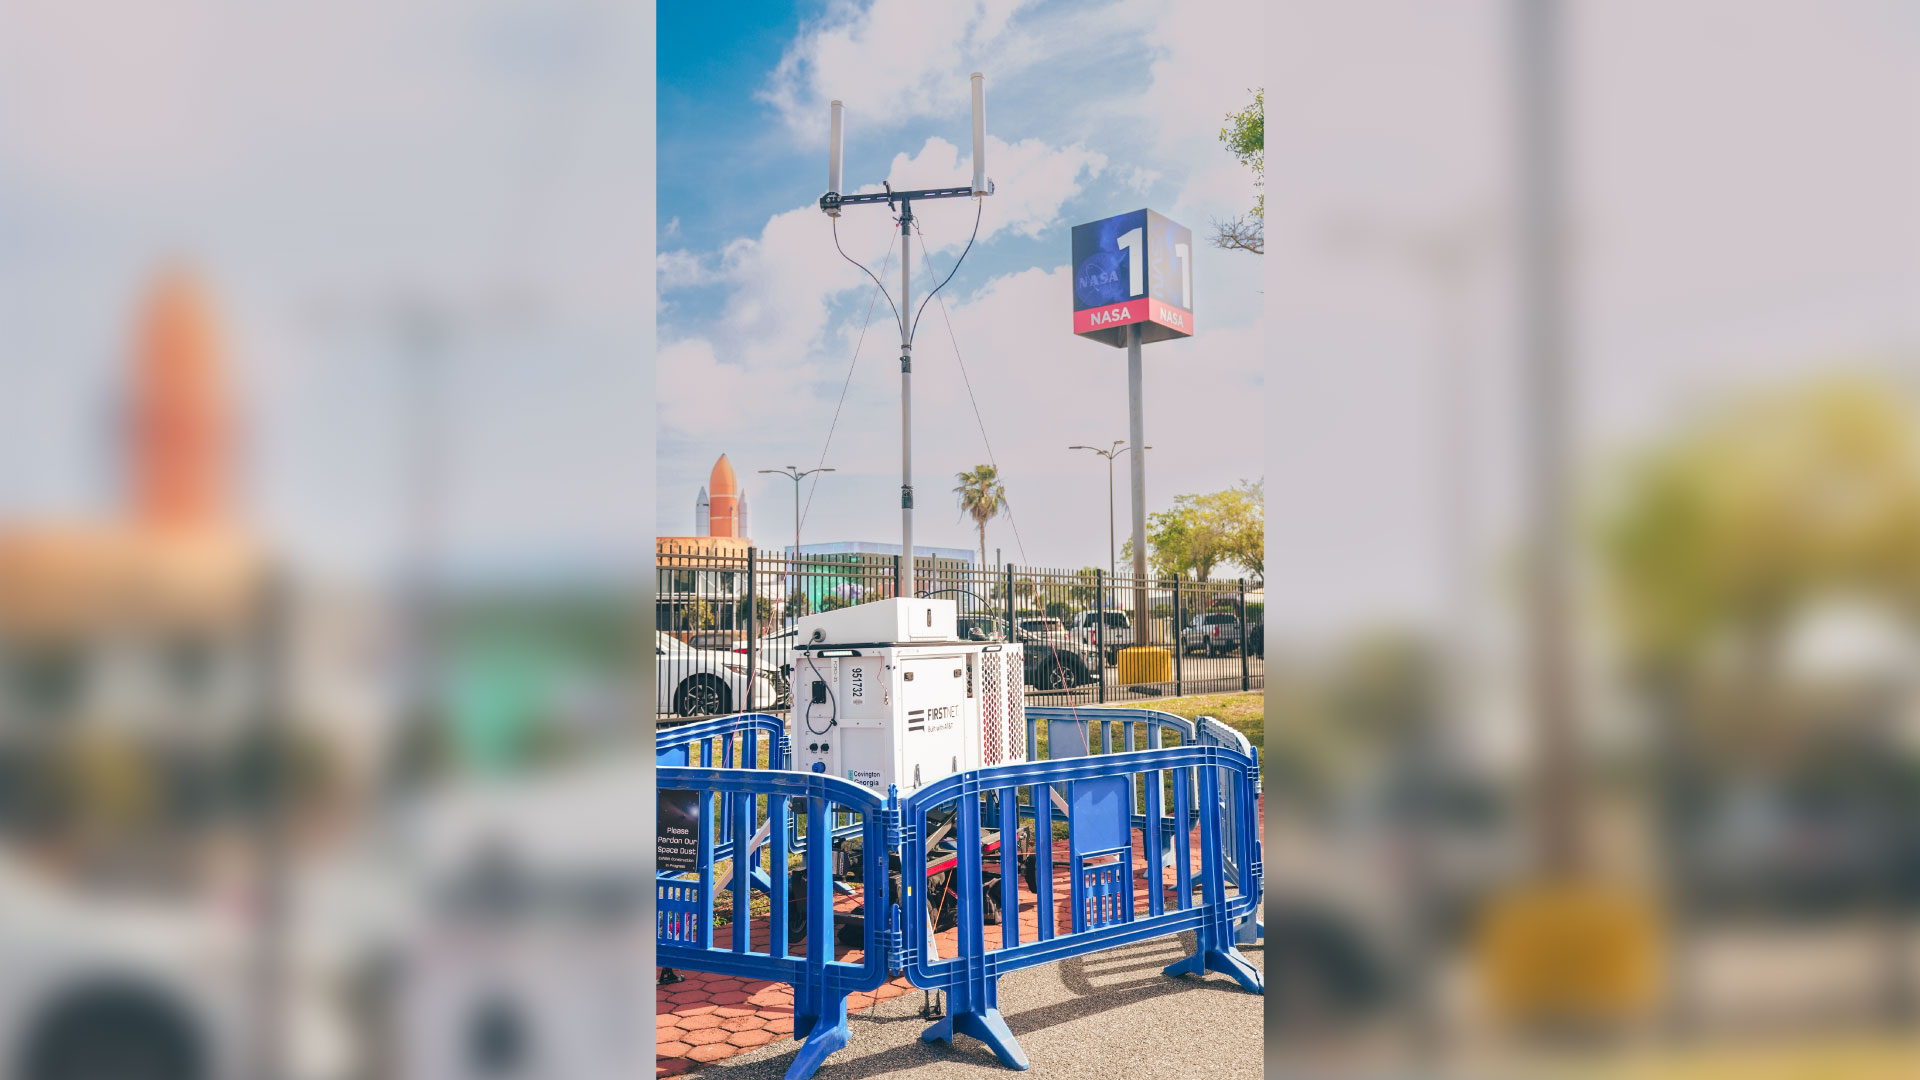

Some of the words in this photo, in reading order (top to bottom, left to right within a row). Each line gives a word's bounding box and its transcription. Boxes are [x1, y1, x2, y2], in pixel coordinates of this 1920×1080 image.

[1117, 227, 1144, 297] 1
[1079, 270, 1119, 289] NASA
[1175, 243, 1190, 310] 1
[1090, 307, 1131, 326] NASA
[1160, 308, 1184, 328] NASA
[852, 668, 863, 697] 951732
[853, 770, 881, 779] Covington
[658, 836, 683, 844] Pardon
[658, 846, 679, 854] Space
[680, 847, 696, 855] Dust
